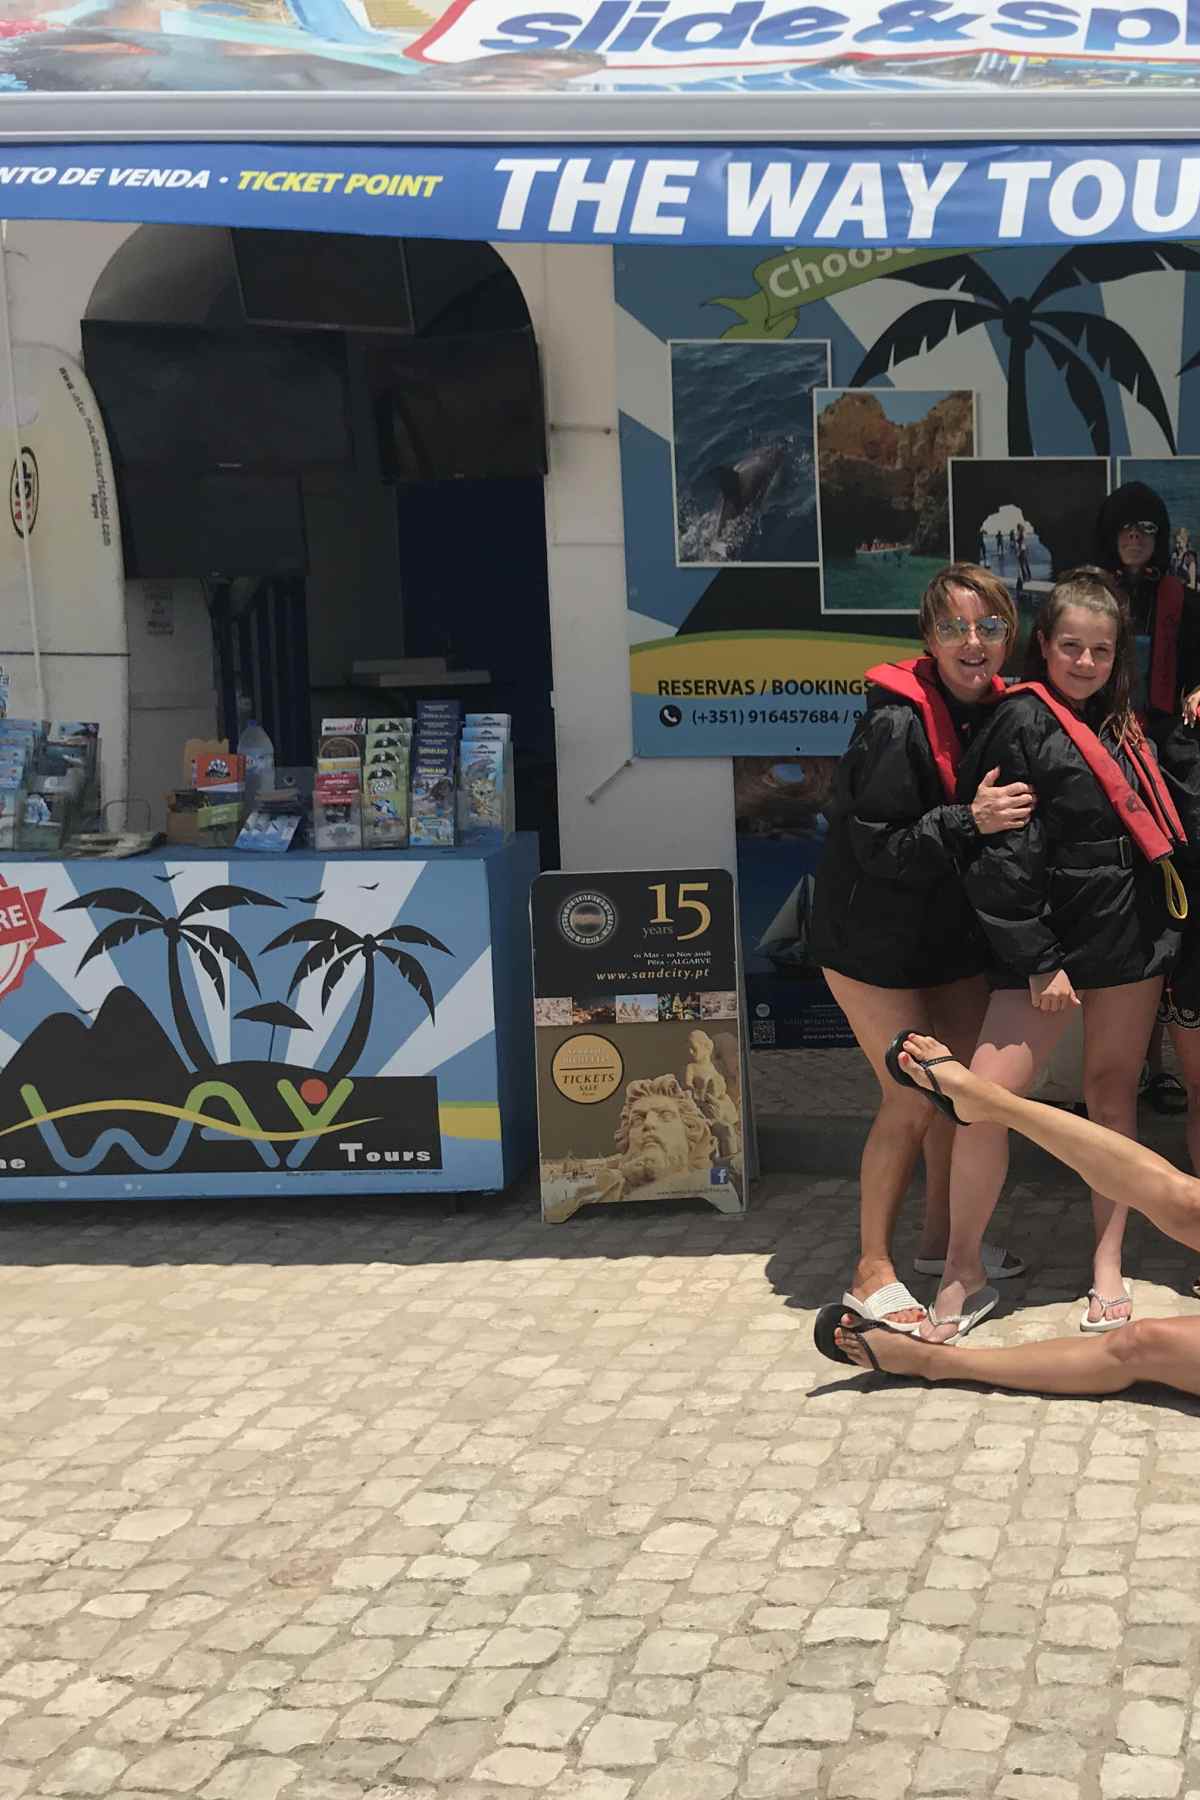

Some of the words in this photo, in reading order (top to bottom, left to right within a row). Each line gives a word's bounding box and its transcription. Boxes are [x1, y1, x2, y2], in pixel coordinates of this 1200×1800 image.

[58, 167, 105, 186] DE
[108, 168, 211, 189] VENDA
[236, 170, 338, 195] TICKET
[348, 173, 443, 199] POINT
[494, 157, 699, 237] THE
[726, 161, 968, 240] WAY
[658, 679, 756, 697] RESERVAS
[759, 679, 768, 697] /
[771, 679, 872, 697] BOOKINGS
[692, 709, 745, 726] (+351)
[749, 709, 839, 724] 916457684
[647, 881, 712, 941] 15
[641, 925, 674, 938] years
[595, 967, 710, 982] www.sandcity.pt
[561, 1071, 615, 1084] TICKETS
[339, 1142, 431, 1164] Tours
